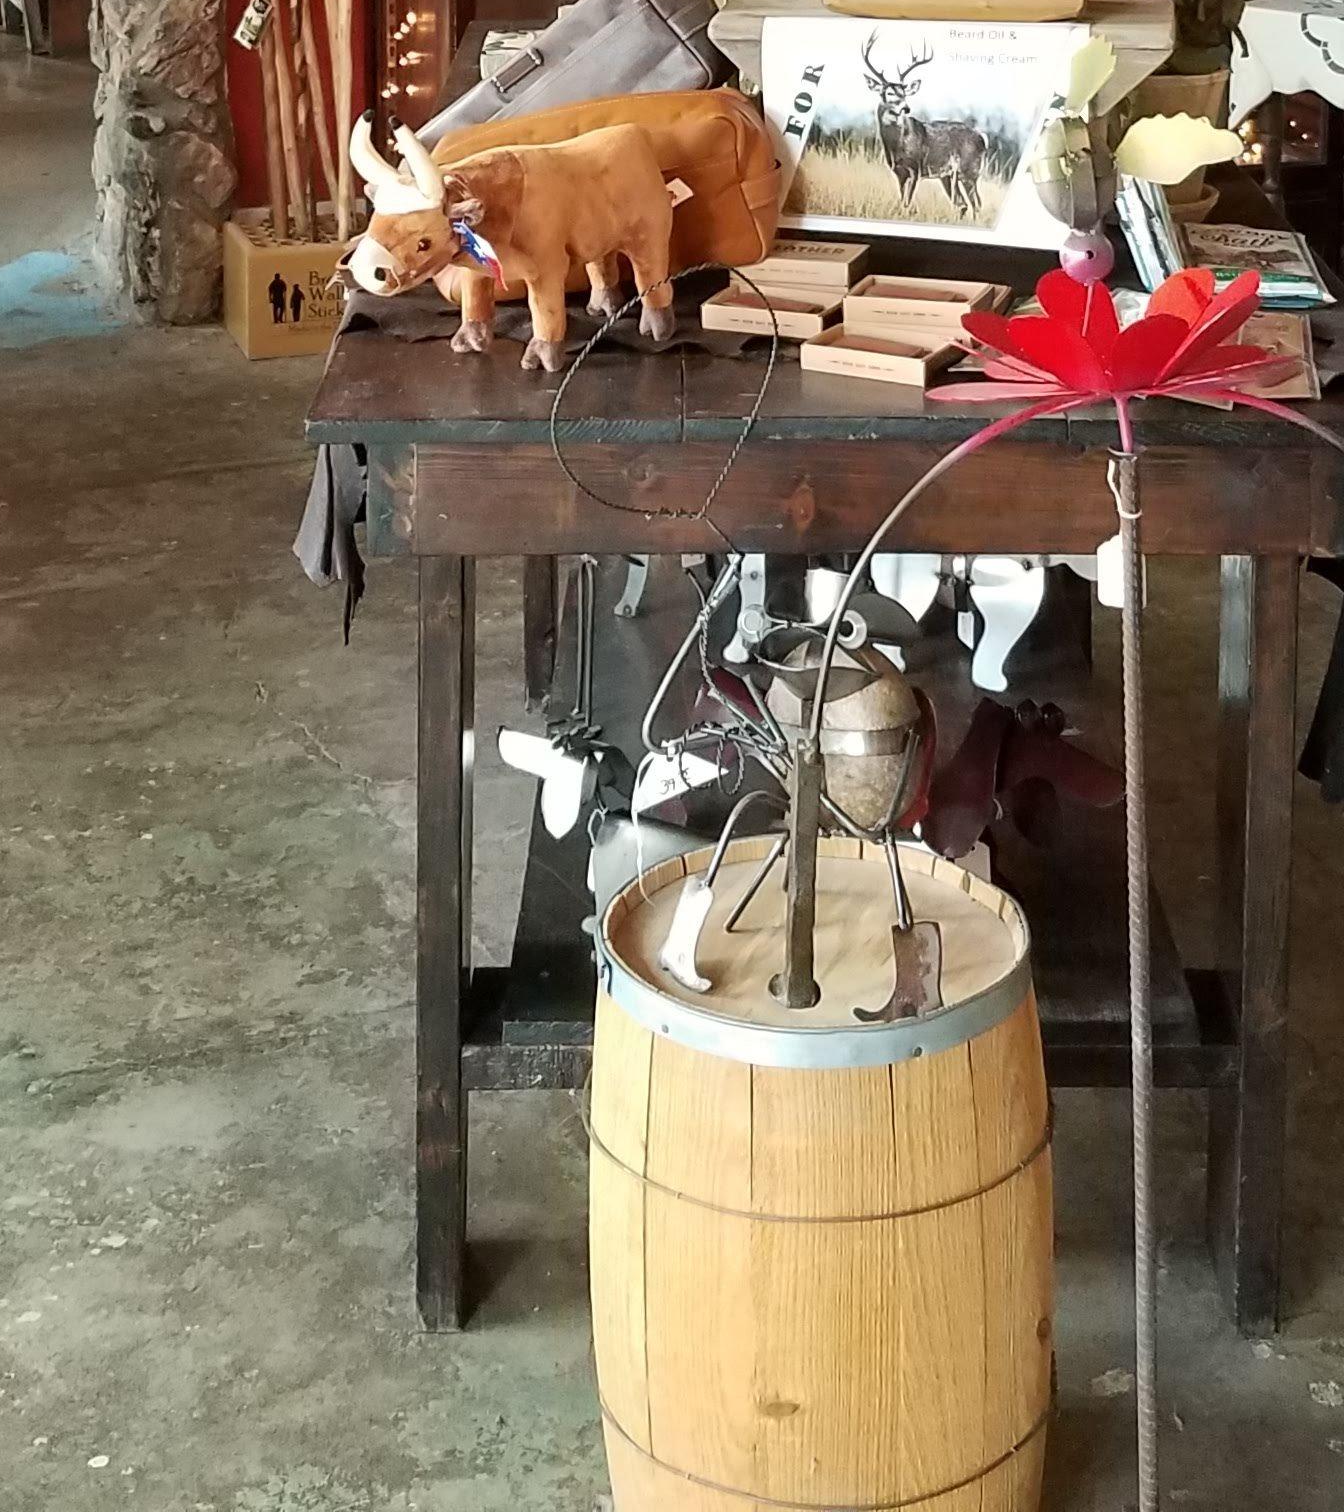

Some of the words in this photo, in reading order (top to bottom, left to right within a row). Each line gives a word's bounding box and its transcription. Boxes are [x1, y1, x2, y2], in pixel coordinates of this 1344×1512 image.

[949, 29, 983, 40] Beard
[988, 29, 1005, 40] Oil
[1009, 30, 1018, 40] &
[949, 52, 994, 65] Shaving
[998, 53, 1038, 64] Cream
[784, 63, 825, 140] FOR
